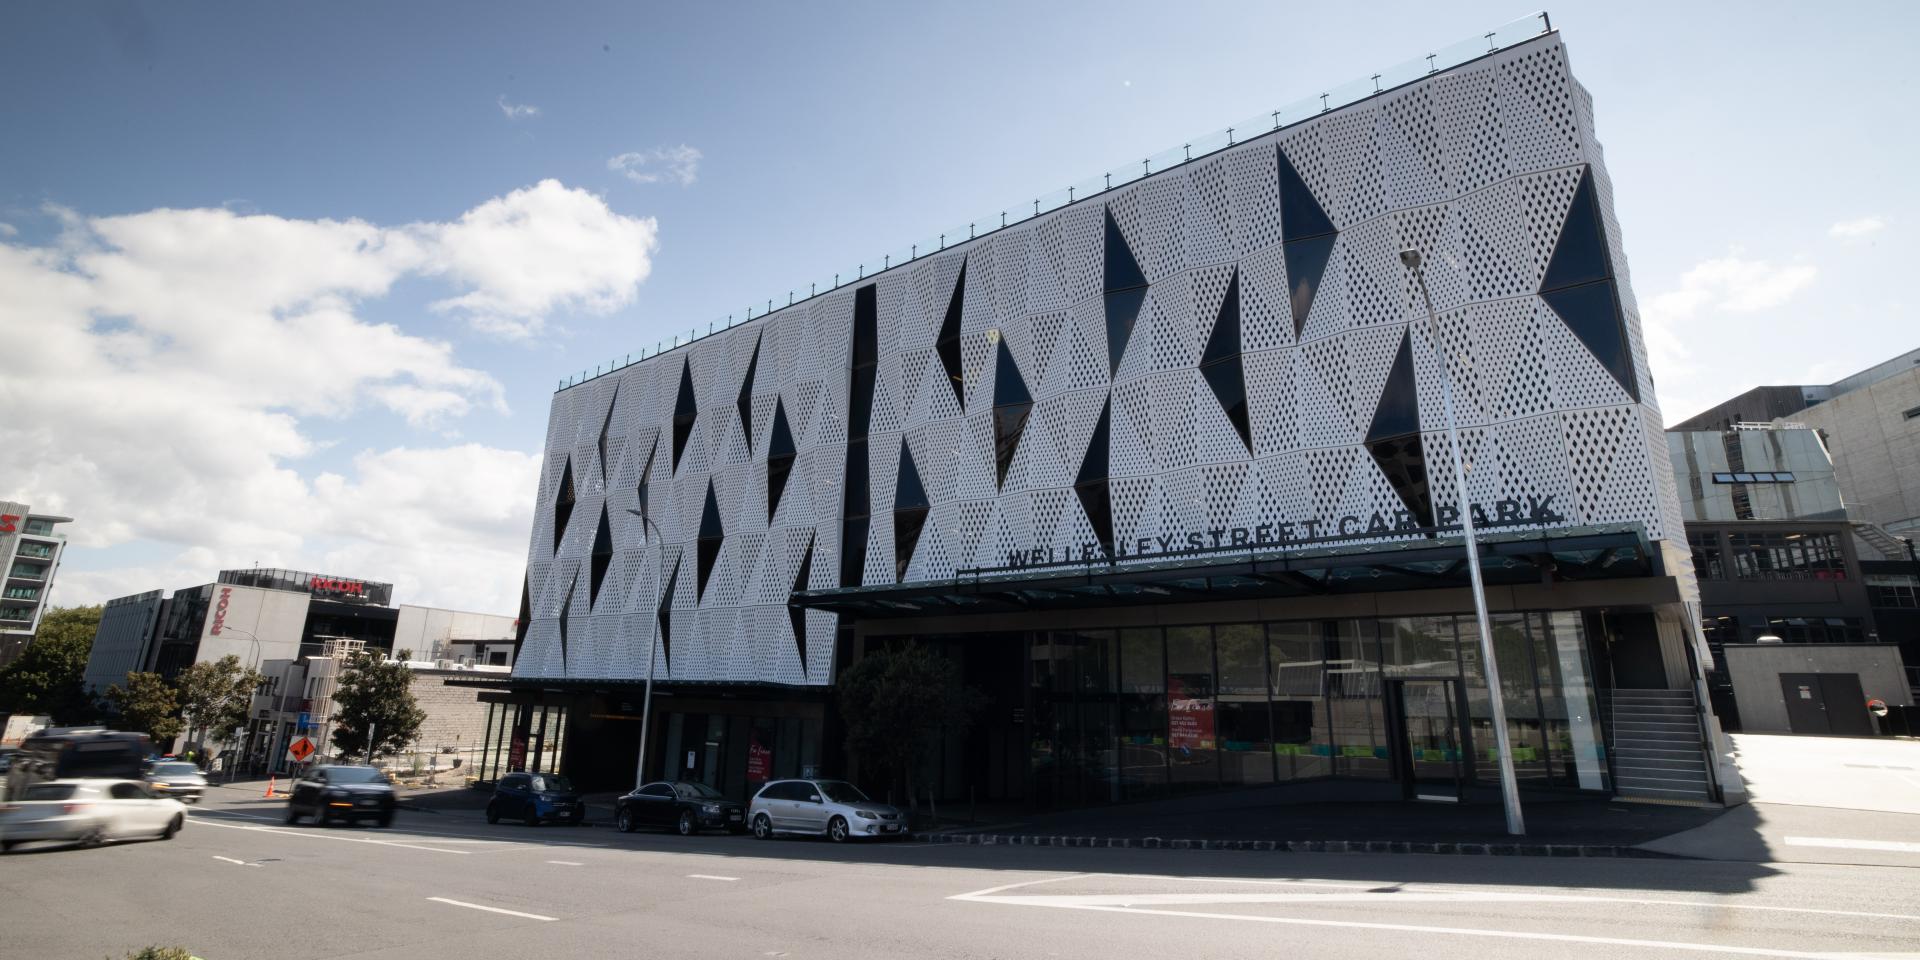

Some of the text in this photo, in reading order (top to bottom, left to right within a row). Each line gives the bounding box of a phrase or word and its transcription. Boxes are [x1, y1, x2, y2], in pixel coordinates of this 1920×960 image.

[1187, 518, 1322, 553] STREET
[1338, 510, 1420, 538] CAR
[1437, 495, 1564, 528] PARK
[311, 576, 363, 593] RICOH
[210, 587, 232, 637] RICOH
